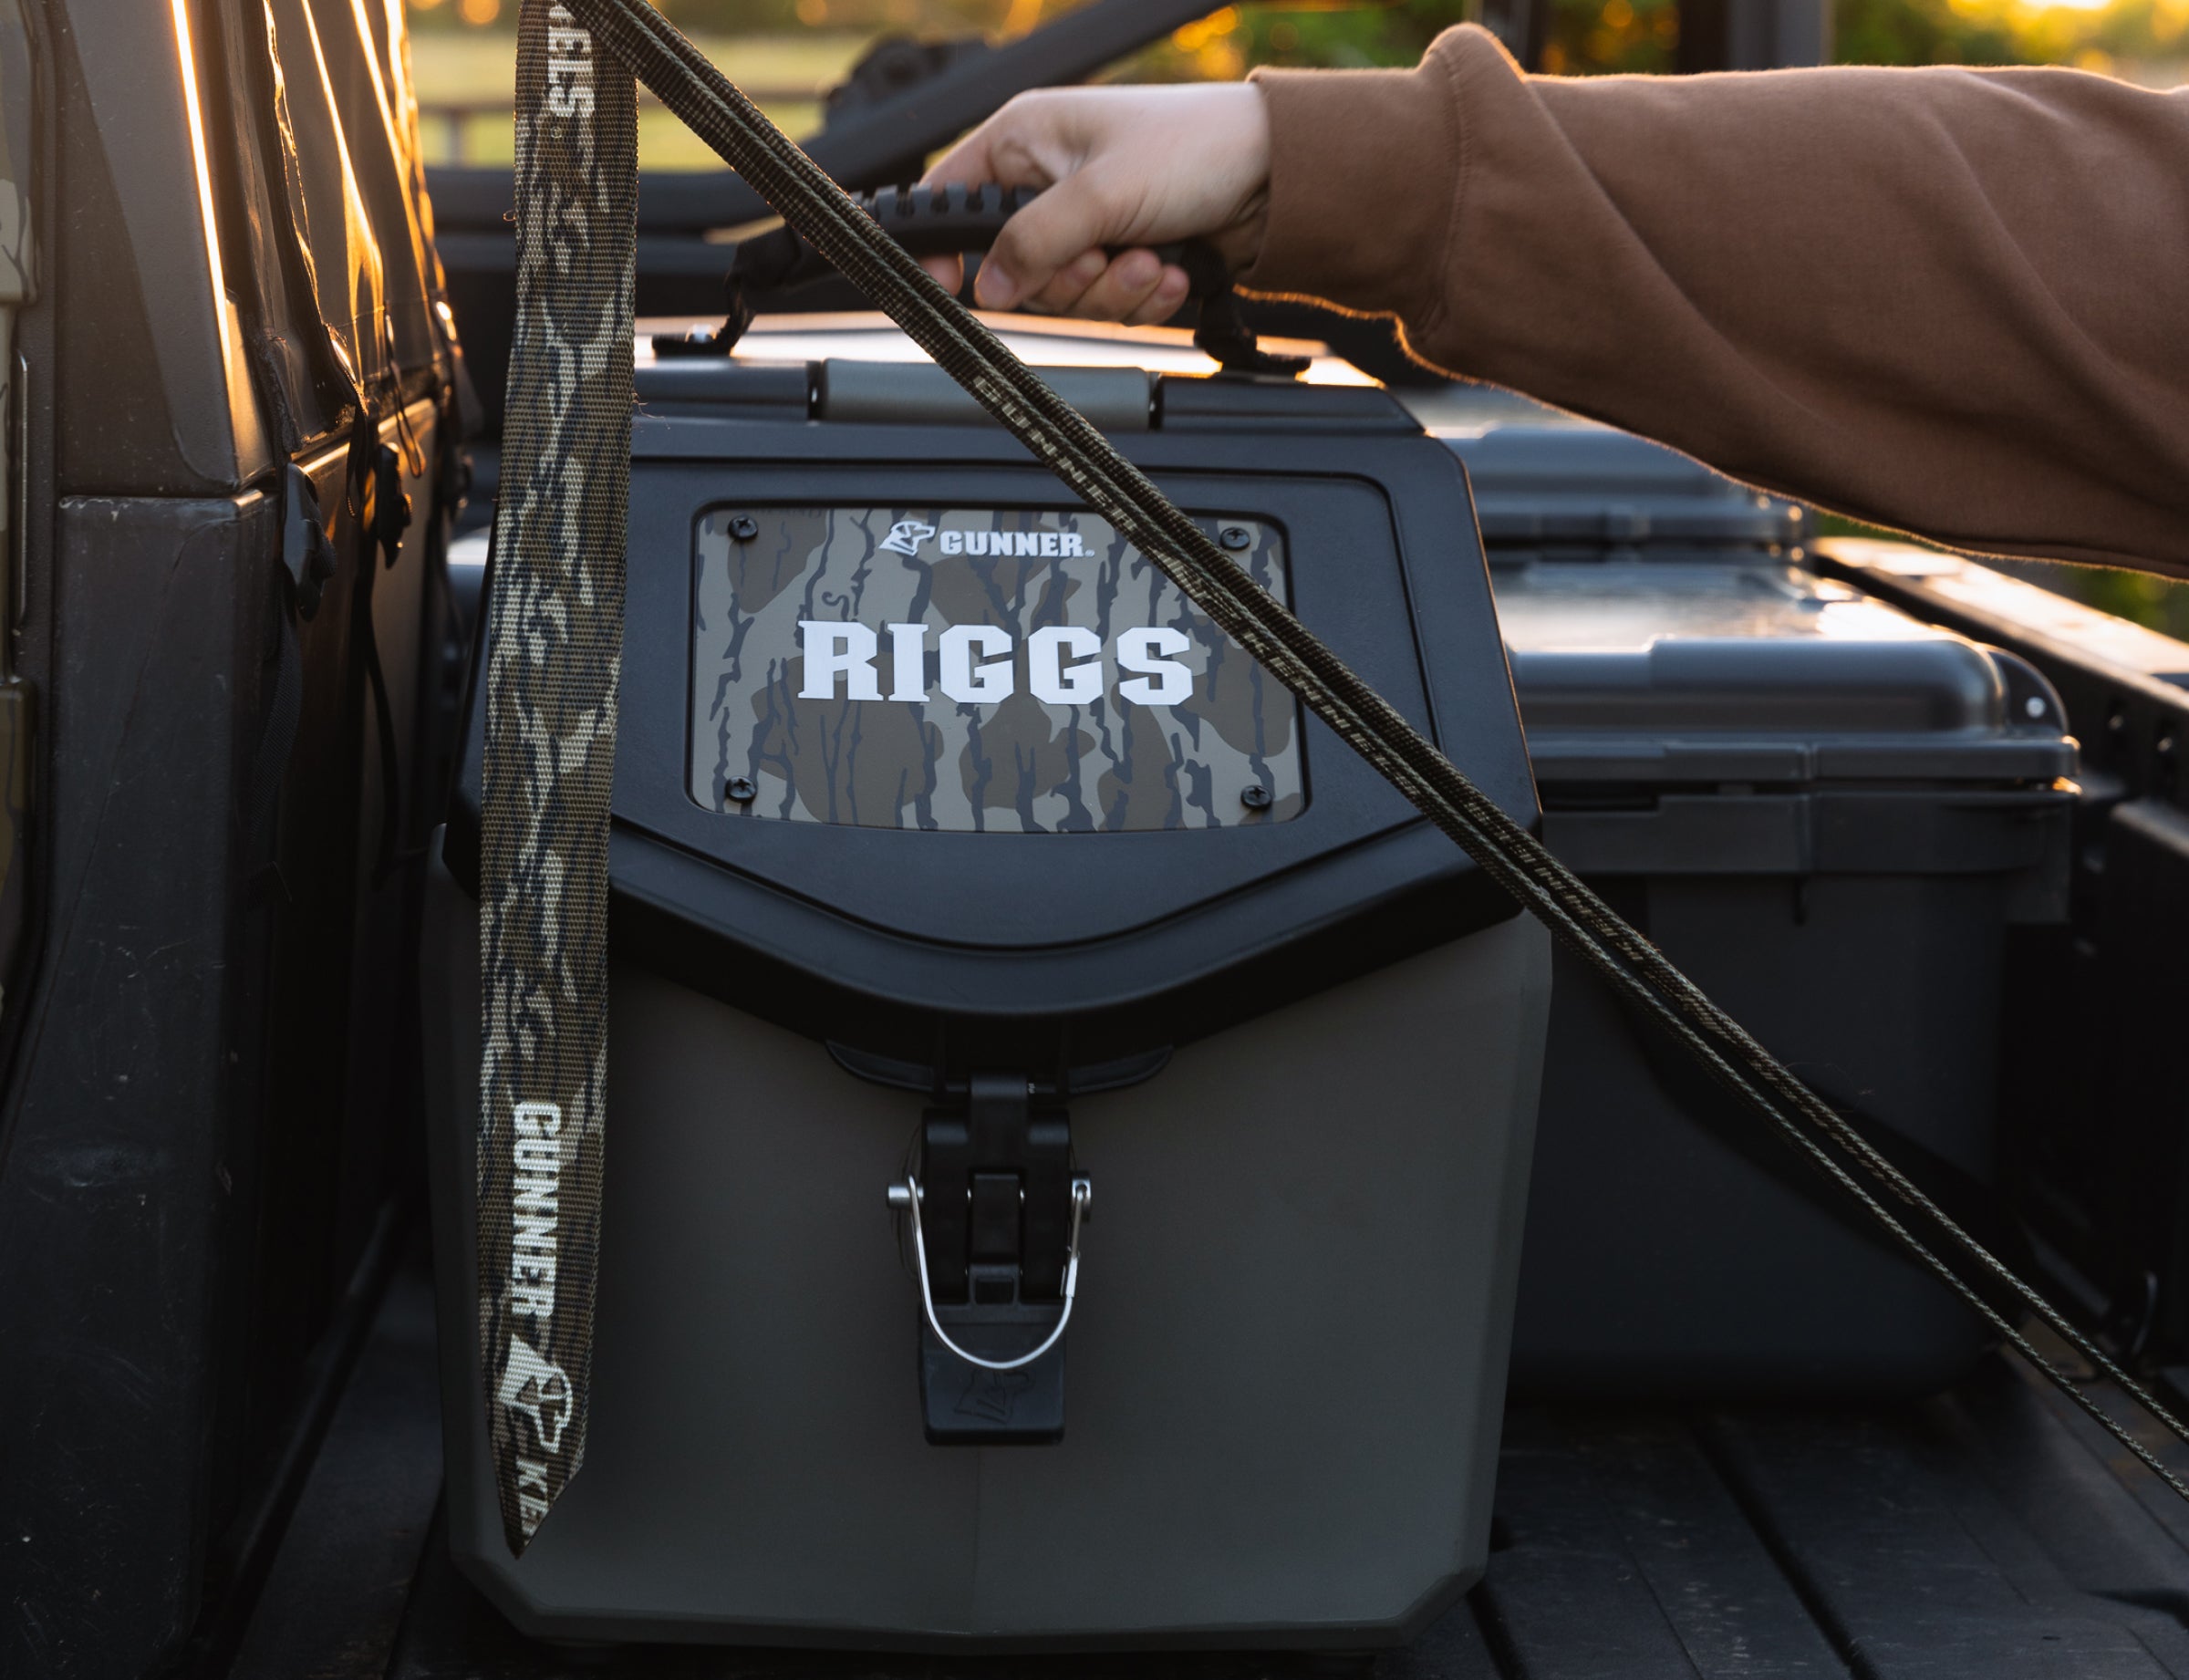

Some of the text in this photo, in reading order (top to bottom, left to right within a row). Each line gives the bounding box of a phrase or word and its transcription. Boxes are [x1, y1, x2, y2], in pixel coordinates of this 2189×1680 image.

[972, 375, 1138, 532] GUNNER
[939, 530, 1084, 557] GUNNER
[797, 620, 1193, 705] RIGGS
[511, 1101, 562, 1317] GUNNER
